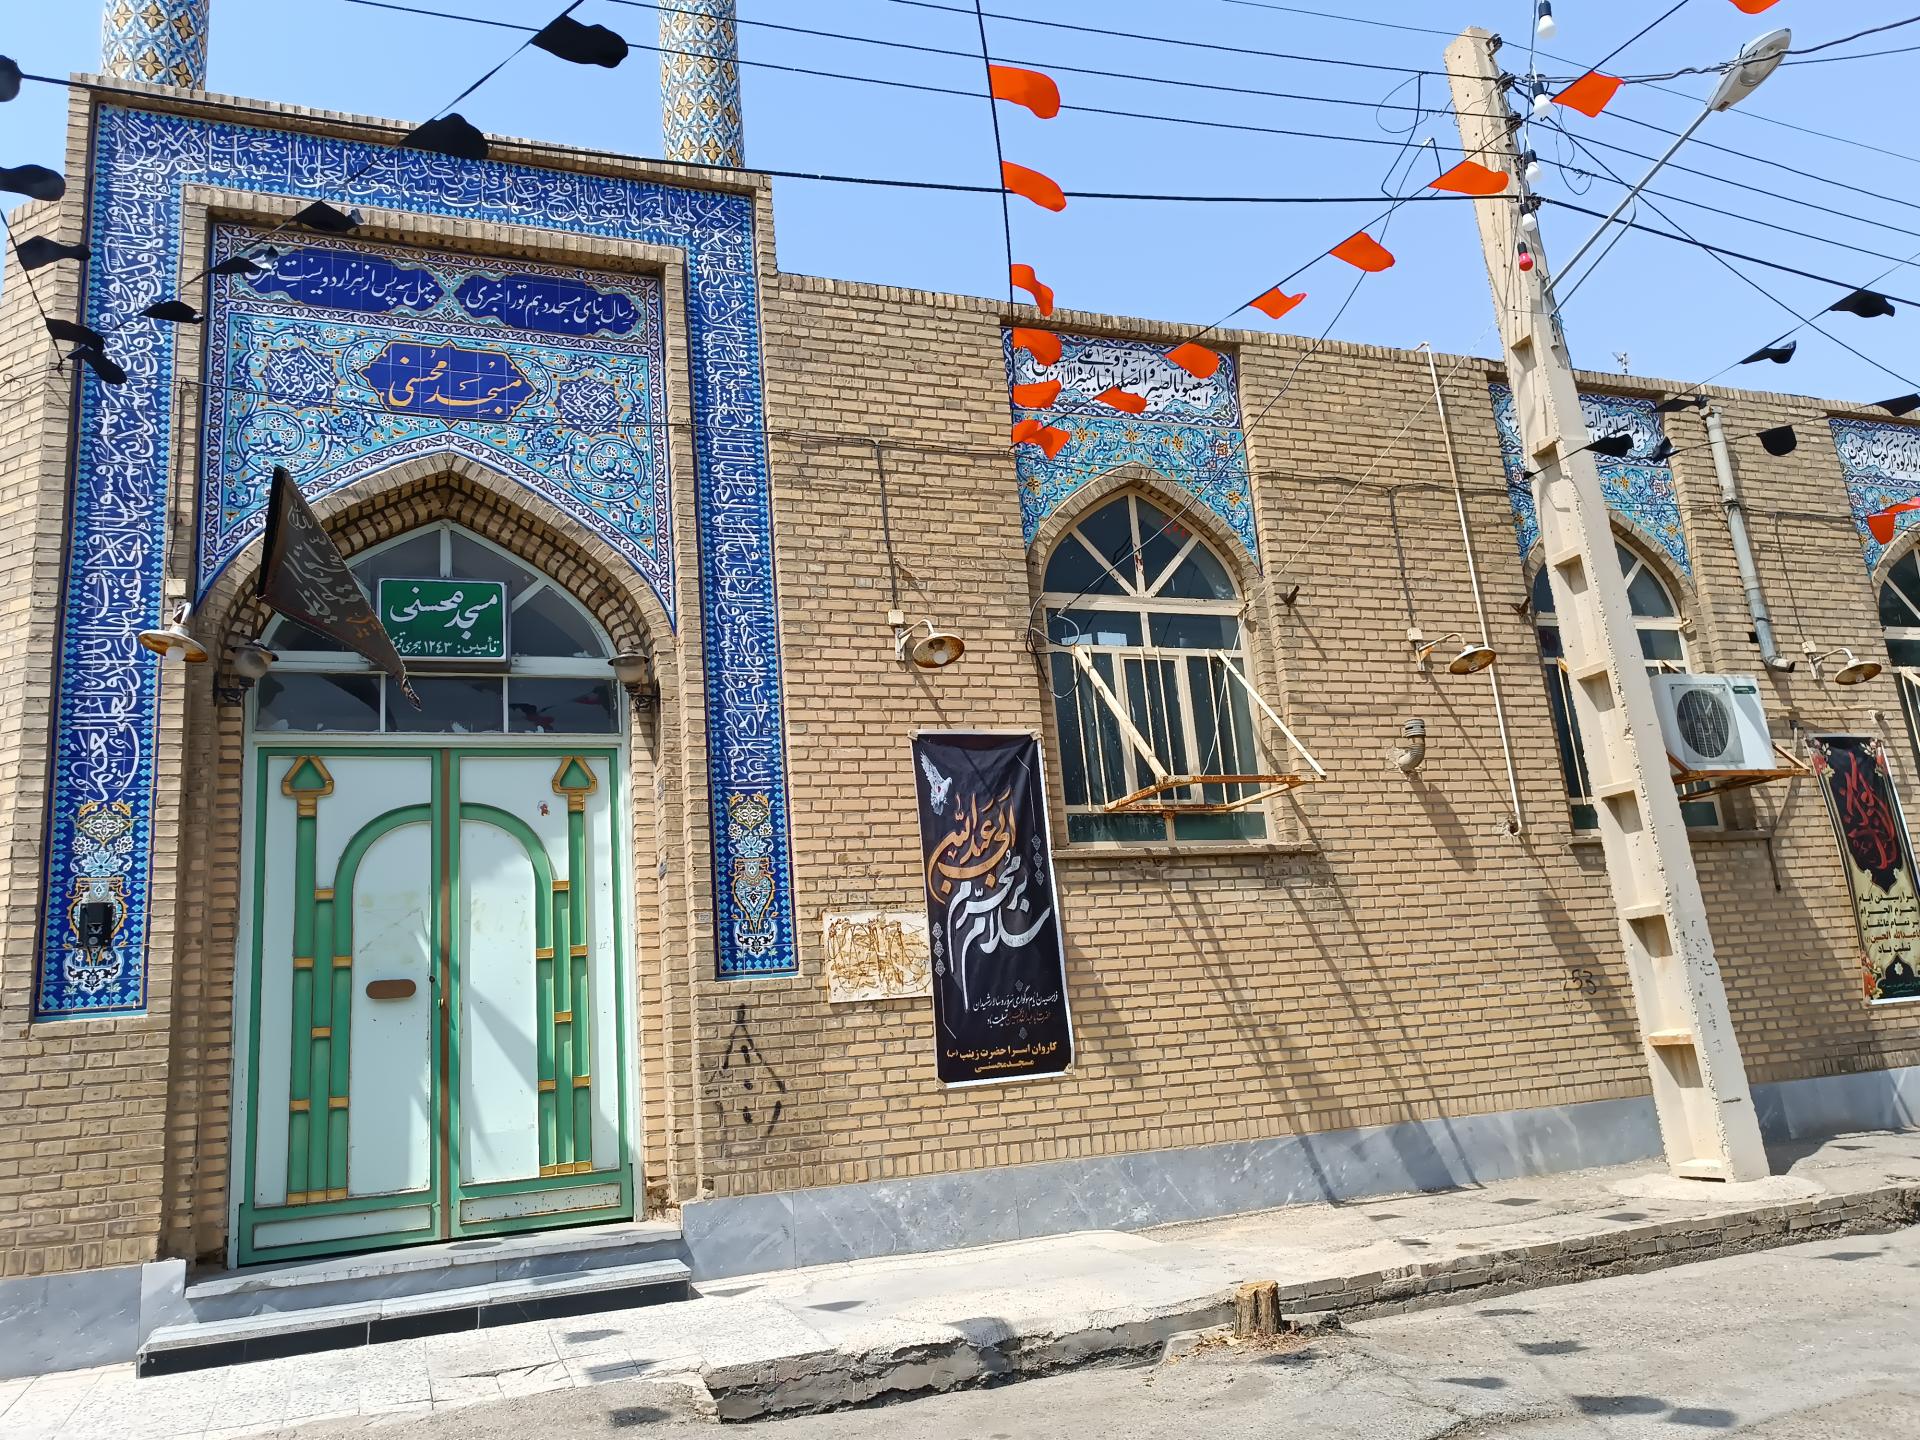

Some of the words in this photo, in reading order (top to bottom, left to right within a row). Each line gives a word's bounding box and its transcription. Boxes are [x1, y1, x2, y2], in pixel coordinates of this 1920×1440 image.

[371, 276, 397, 306] پس
[403, 279, 436, 306] چهل
[466, 284, 504, 312] خبری
[548, 296, 581, 323] مسجد
[388, 356, 447, 406] محسنی
[424, 379, 522, 414] مسجد
[389, 586, 464, 622] محسنی
[443, 593, 498, 640] مسجد
[961, 904, 1052, 1013] سلام
[960, 1049, 979, 1061] زینب
[981, 1046, 1006, 1059] حضرت
[1032, 1041, 1057, 1054] کاروان
